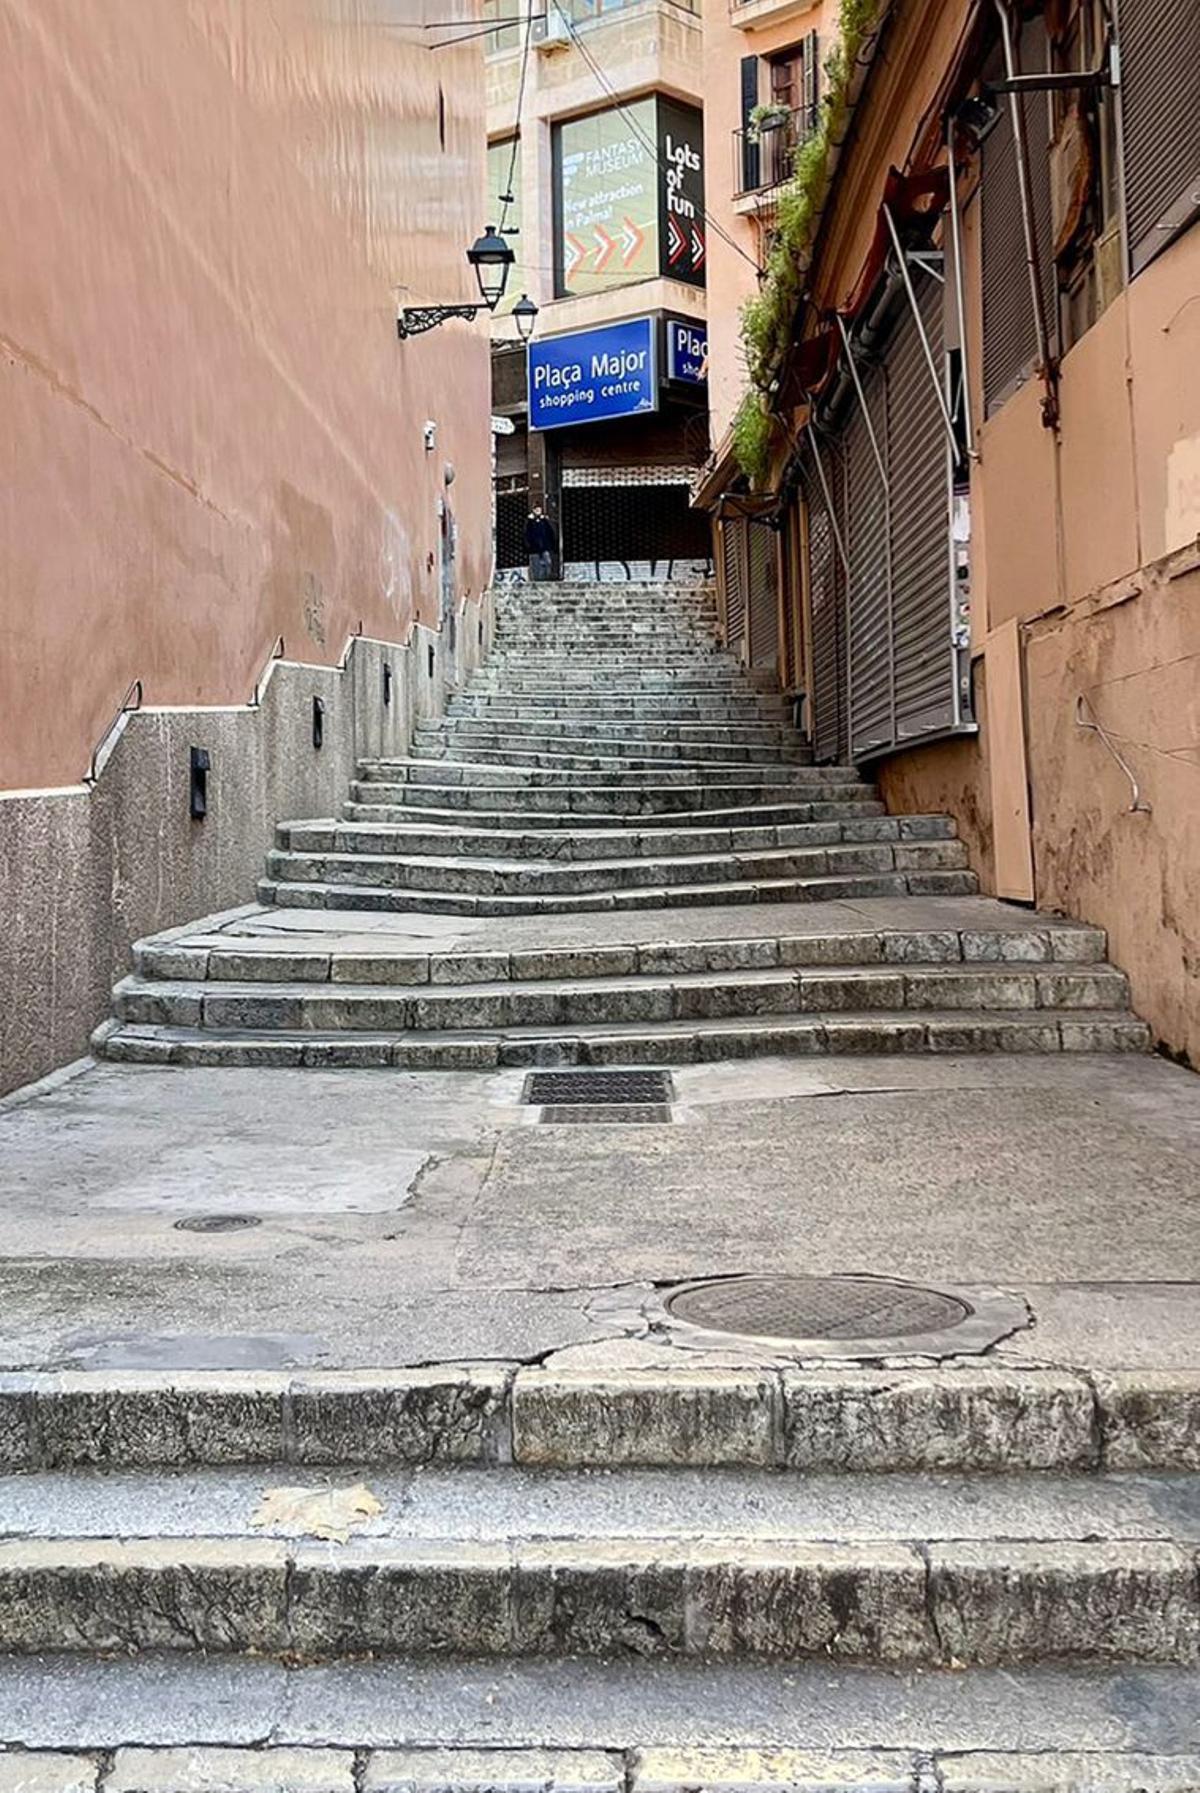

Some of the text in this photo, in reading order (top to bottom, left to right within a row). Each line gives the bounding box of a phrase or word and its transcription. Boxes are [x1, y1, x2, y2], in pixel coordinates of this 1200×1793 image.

[586, 139, 642, 166] FANTASY
[586, 151, 643, 177] MUSEUM
[666, 134, 700, 170] Lots
[666, 165, 684, 189] of
[588, 182, 643, 207] attraction
[534, 350, 647, 390] Plaça Major
[539, 380, 641, 409] shopping centre
